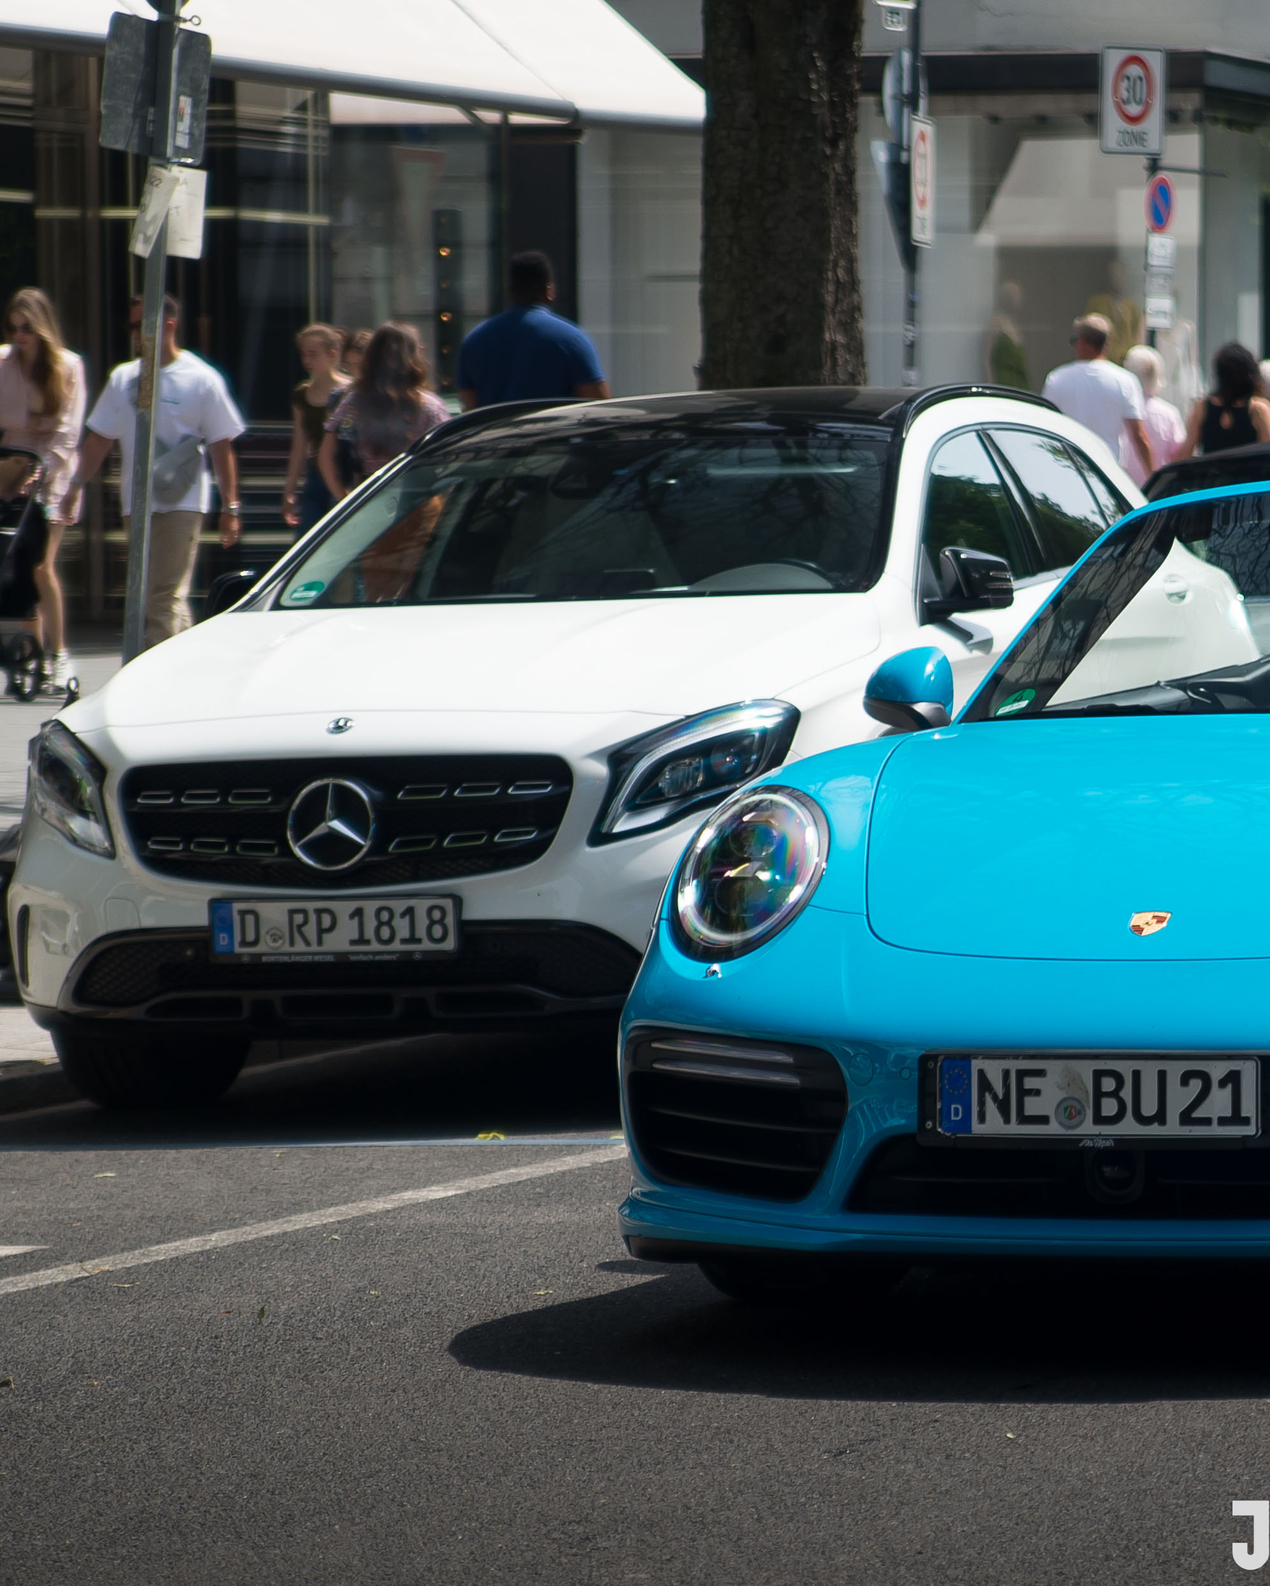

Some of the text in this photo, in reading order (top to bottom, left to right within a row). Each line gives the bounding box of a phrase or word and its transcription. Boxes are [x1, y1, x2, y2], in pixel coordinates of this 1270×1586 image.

[1121, 73, 1145, 107] 30
[1116, 130, 1148, 148] ZONE
[237, 905, 449, 948] D RP 1818
[951, 1104, 962, 1120] D
[976, 1069, 1252, 1126] NE BU 21
